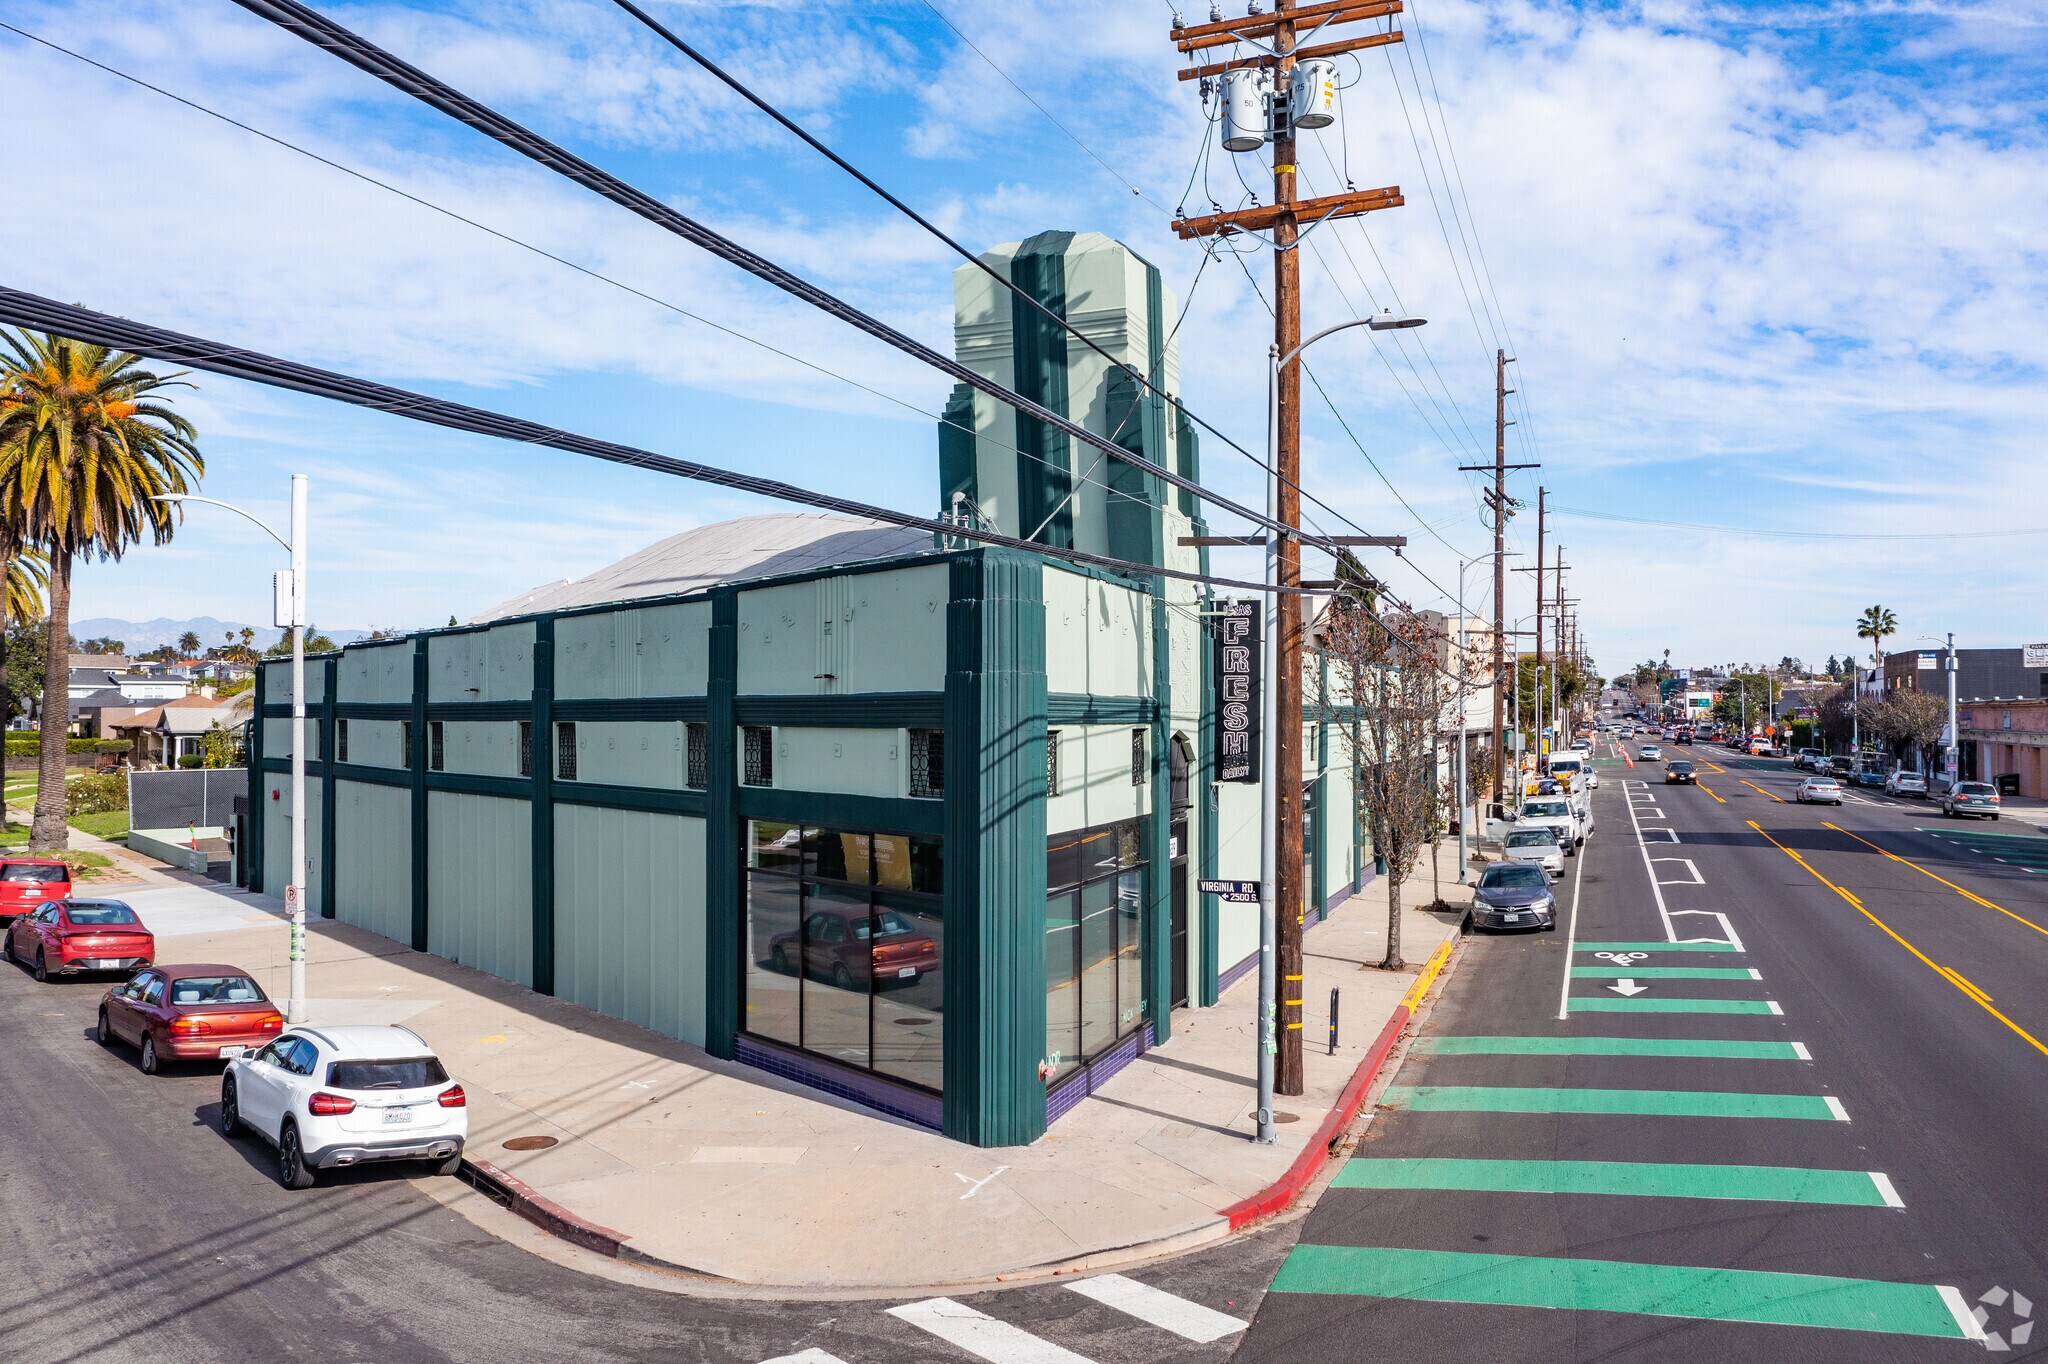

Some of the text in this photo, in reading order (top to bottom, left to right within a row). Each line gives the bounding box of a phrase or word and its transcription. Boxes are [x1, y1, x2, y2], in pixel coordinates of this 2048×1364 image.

[1244, 99, 1253, 107] 50
[1223, 617, 1250, 755] FRESH
[1200, 881, 1256, 893] VIRGINIA RD.
[1230, 893, 1250, 901] 2500
